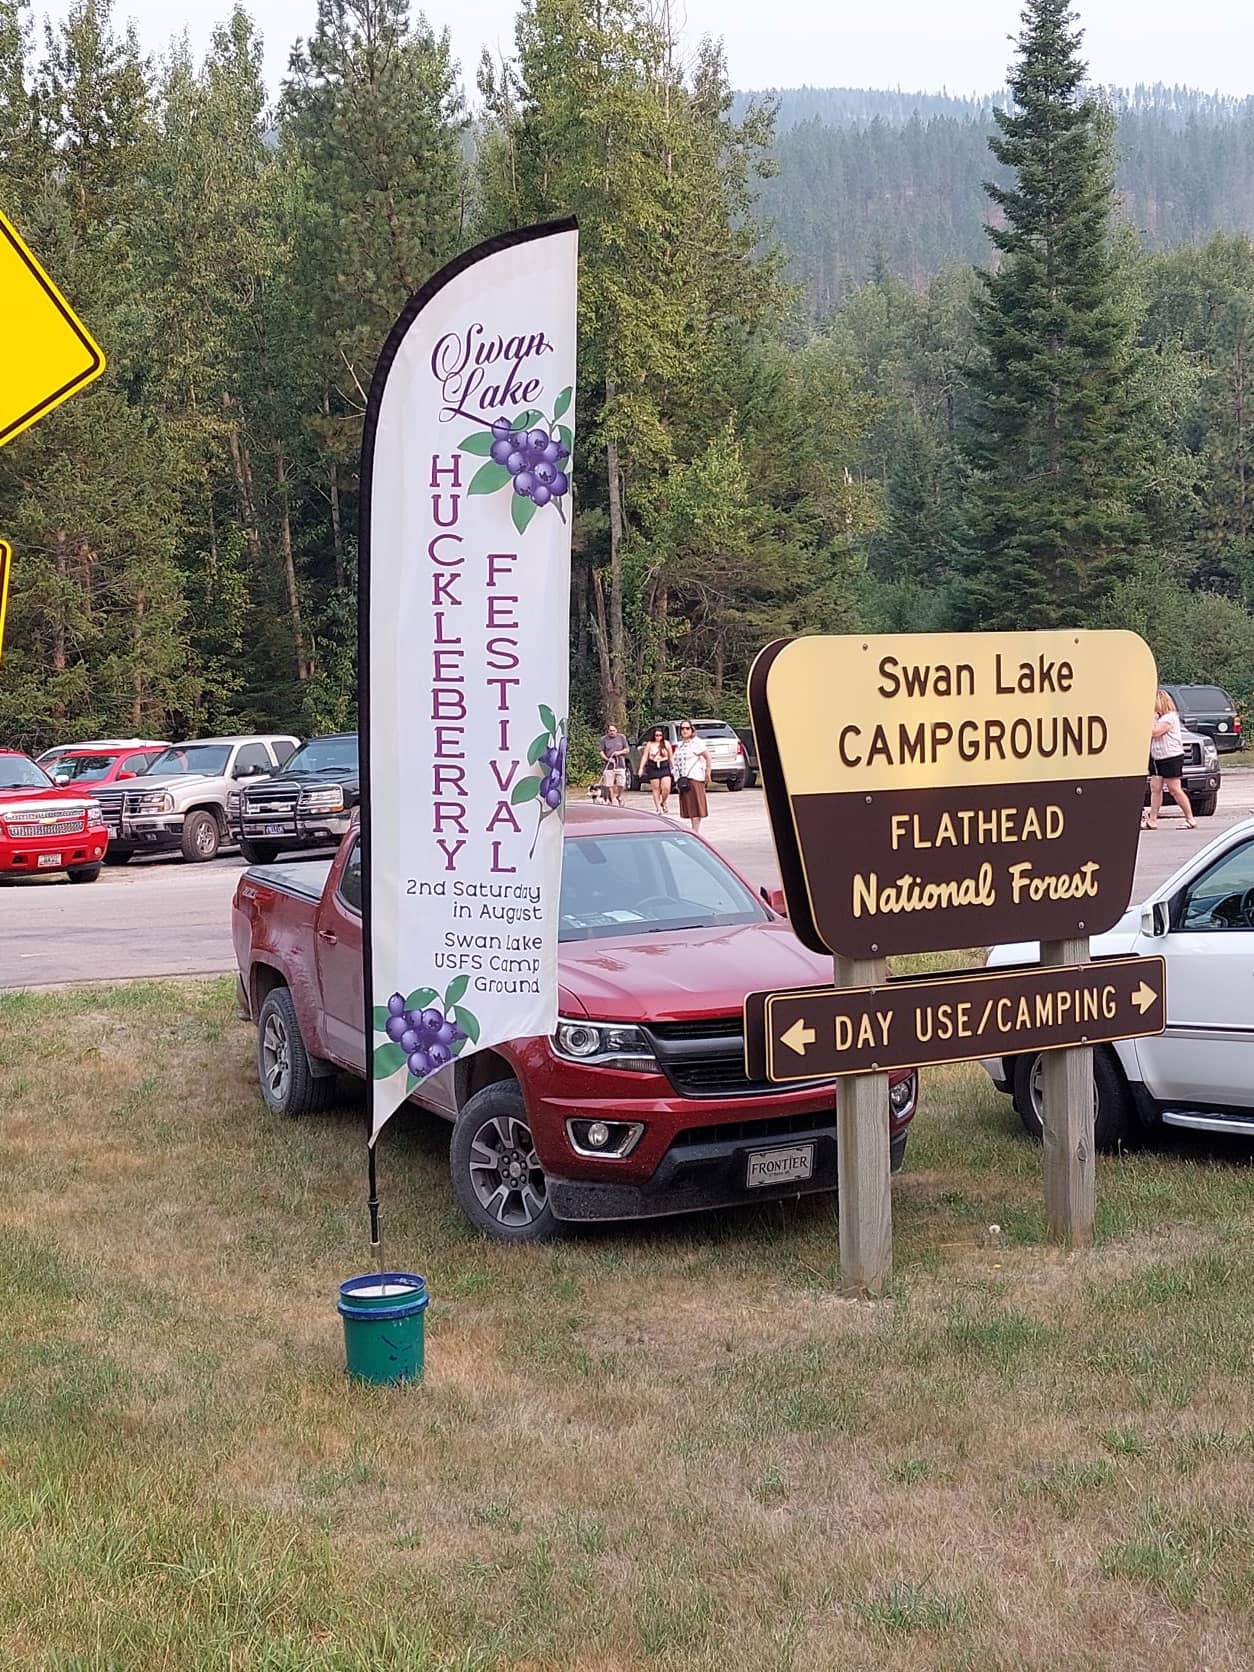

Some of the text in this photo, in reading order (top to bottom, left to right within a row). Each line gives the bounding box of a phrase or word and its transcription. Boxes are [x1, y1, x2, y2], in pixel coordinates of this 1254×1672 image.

[431, 323, 553, 381] Swan
[438, 357, 543, 431] Lake
[428, 454, 468, 871] HUCKLEBERRY
[878, 653, 1074, 699] Swan Lake
[486, 554, 521, 873] FESTIVAL
[838, 715, 1108, 768] CAMPGROUND
[890, 804, 1065, 850] FLATHEAD
[406, 879, 541, 903] 2nd Saturday
[852, 860, 1100, 918] National Forest
[453, 901, 543, 924] in August
[444, 931, 501, 949] Swan
[434, 953, 540, 974] USFS Camp
[474, 976, 540, 993] Ground
[835, 984, 1117, 1051] DAY USE/CAMPING
[751, 1155, 808, 1176] FRONTIER
